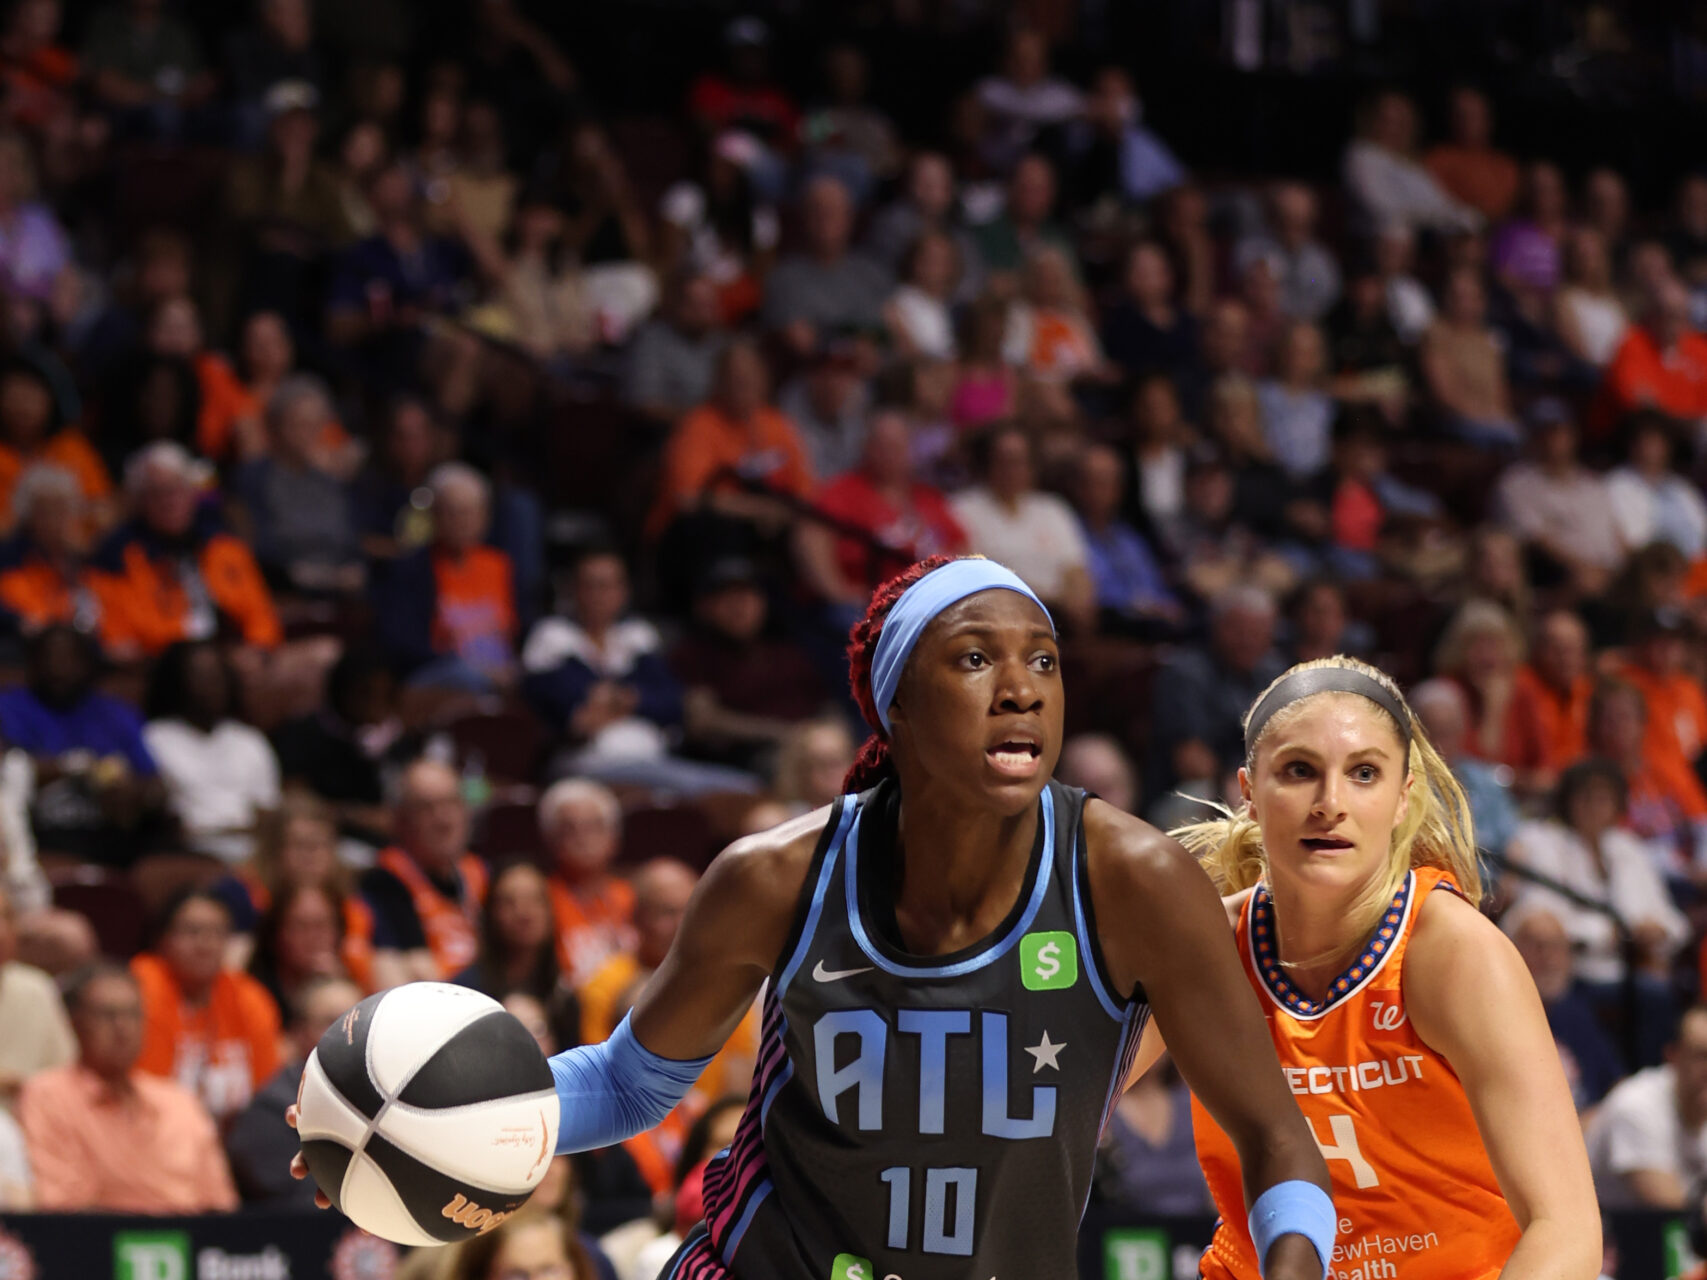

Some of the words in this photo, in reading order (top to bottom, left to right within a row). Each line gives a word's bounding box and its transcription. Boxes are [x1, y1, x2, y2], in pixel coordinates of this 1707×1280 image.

[813, 1009, 1057, 1140] ATL
[1282, 1055, 1423, 1095] ECTICUT
[881, 1166, 978, 1256] 10
[1331, 1231, 1439, 1263] ewHaven
